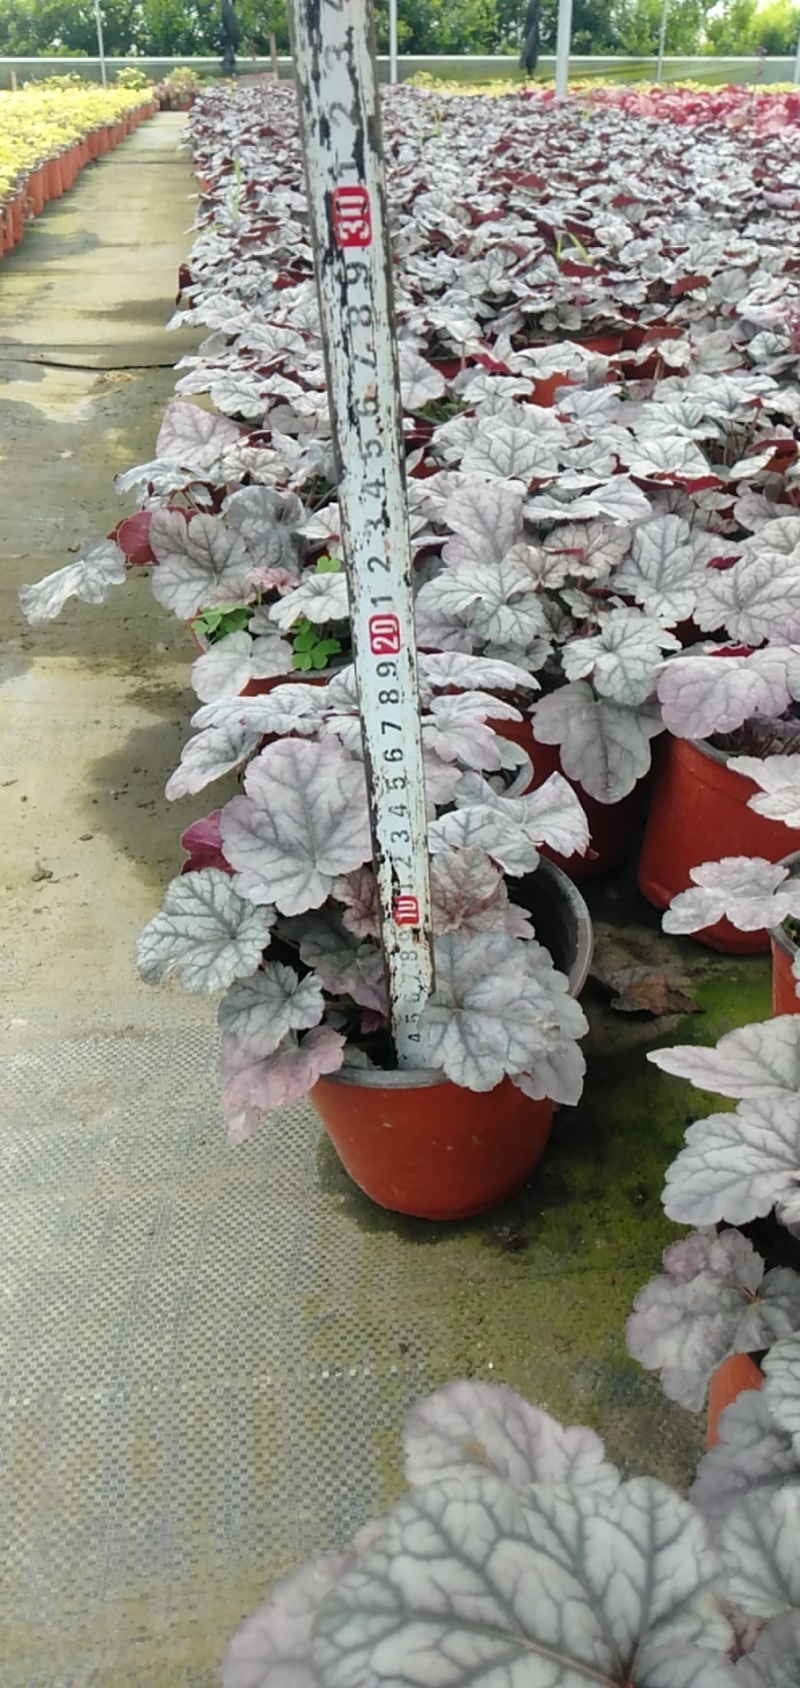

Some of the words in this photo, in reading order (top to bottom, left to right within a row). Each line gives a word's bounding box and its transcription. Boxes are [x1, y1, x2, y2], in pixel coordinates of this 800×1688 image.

[334, 194, 370, 241] 30
[345, 261, 370, 285] 9
[346, 304, 371, 327] 8
[353, 348, 377, 368] 7
[354, 397, 379, 417] 6
[360, 439, 382, 460] 5
[361, 478, 386, 499] 4
[364, 517, 388, 537] 3
[367, 555, 391, 573] 2
[370, 594, 393, 607] 1
[371, 618, 399, 650] 20
[376, 660, 397, 678] 9
[378, 689, 399, 704] 8
[381, 720, 402, 735] 7
[384, 747, 404, 763] 6
[386, 776, 406, 790] 5
[388, 804, 407, 818] 4
[391, 829, 410, 844] 3
[394, 856, 412, 869] 2
[396, 898, 418, 920] 10
[399, 950, 418, 962] 8
[405, 1012, 420, 1024] 5
[408, 1034, 421, 1044] 4
